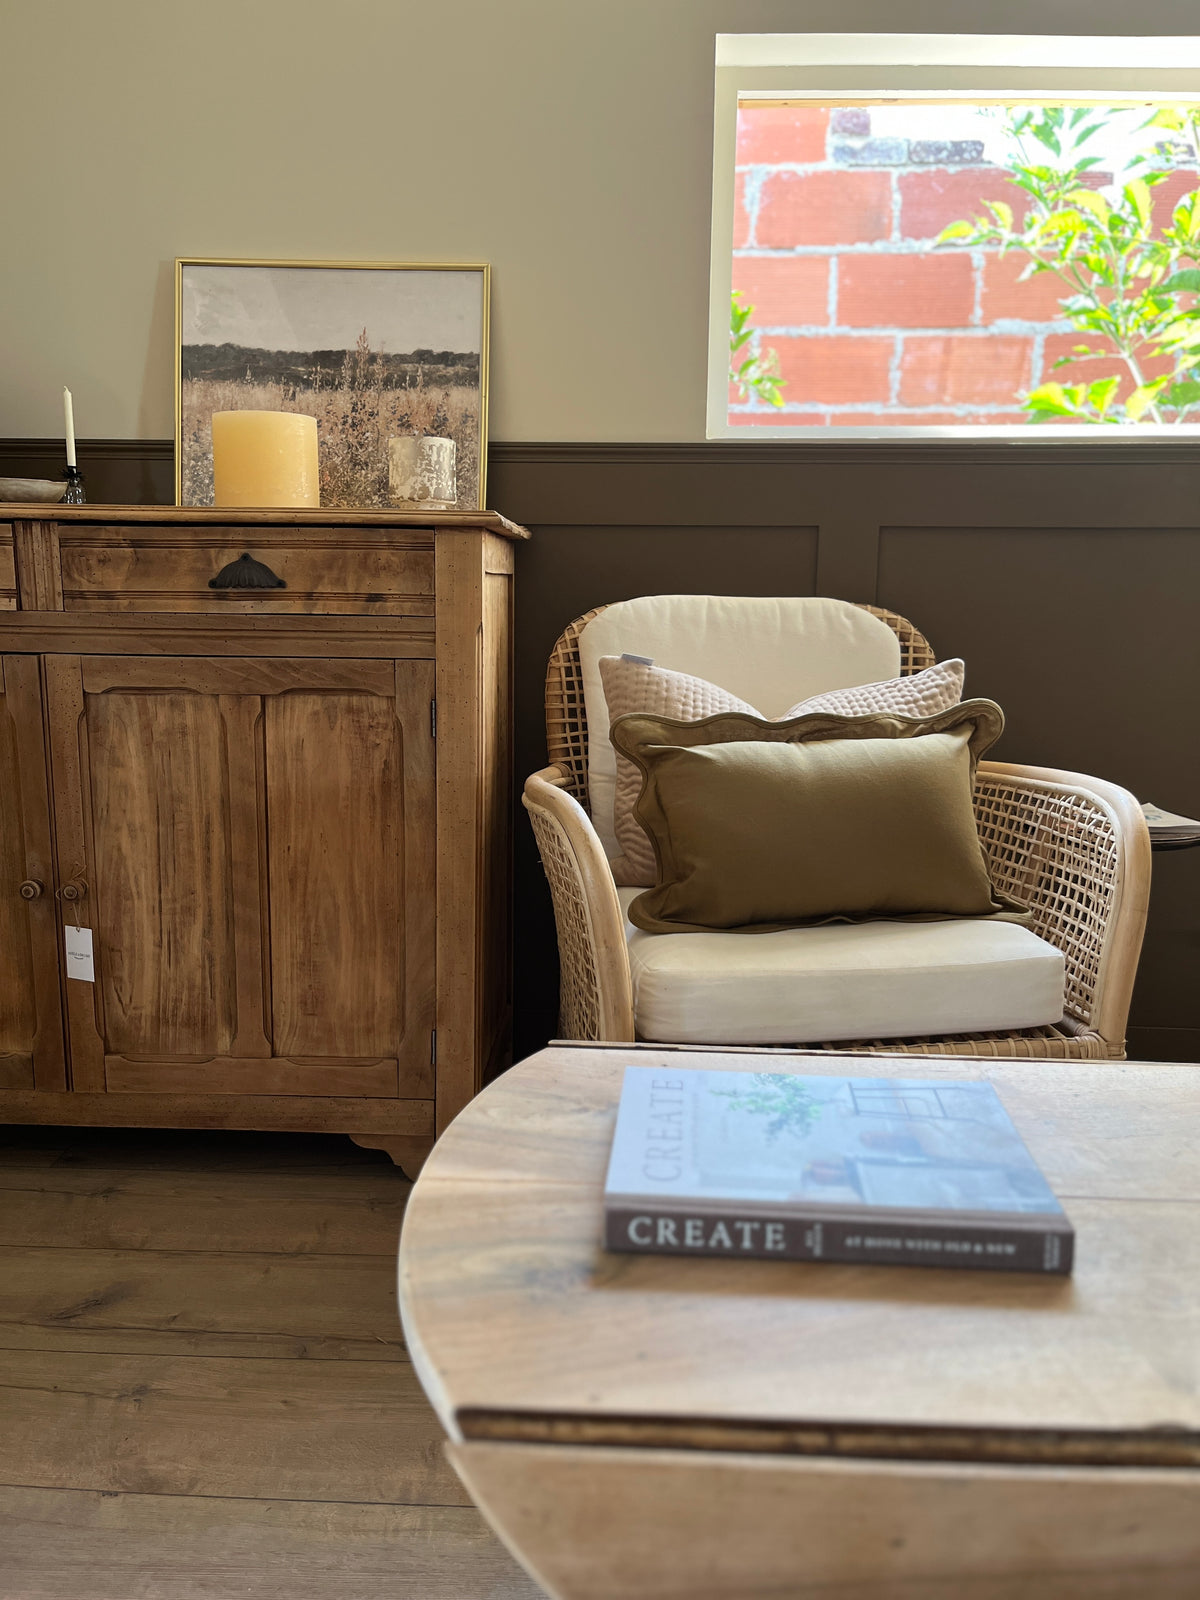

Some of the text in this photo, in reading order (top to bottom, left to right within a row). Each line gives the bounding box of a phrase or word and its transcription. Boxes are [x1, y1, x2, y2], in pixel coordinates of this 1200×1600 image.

[641, 1079, 684, 1182] CREATE
[626, 1216, 786, 1251] CREATE
[905, 1238, 942, 1252] WITH
